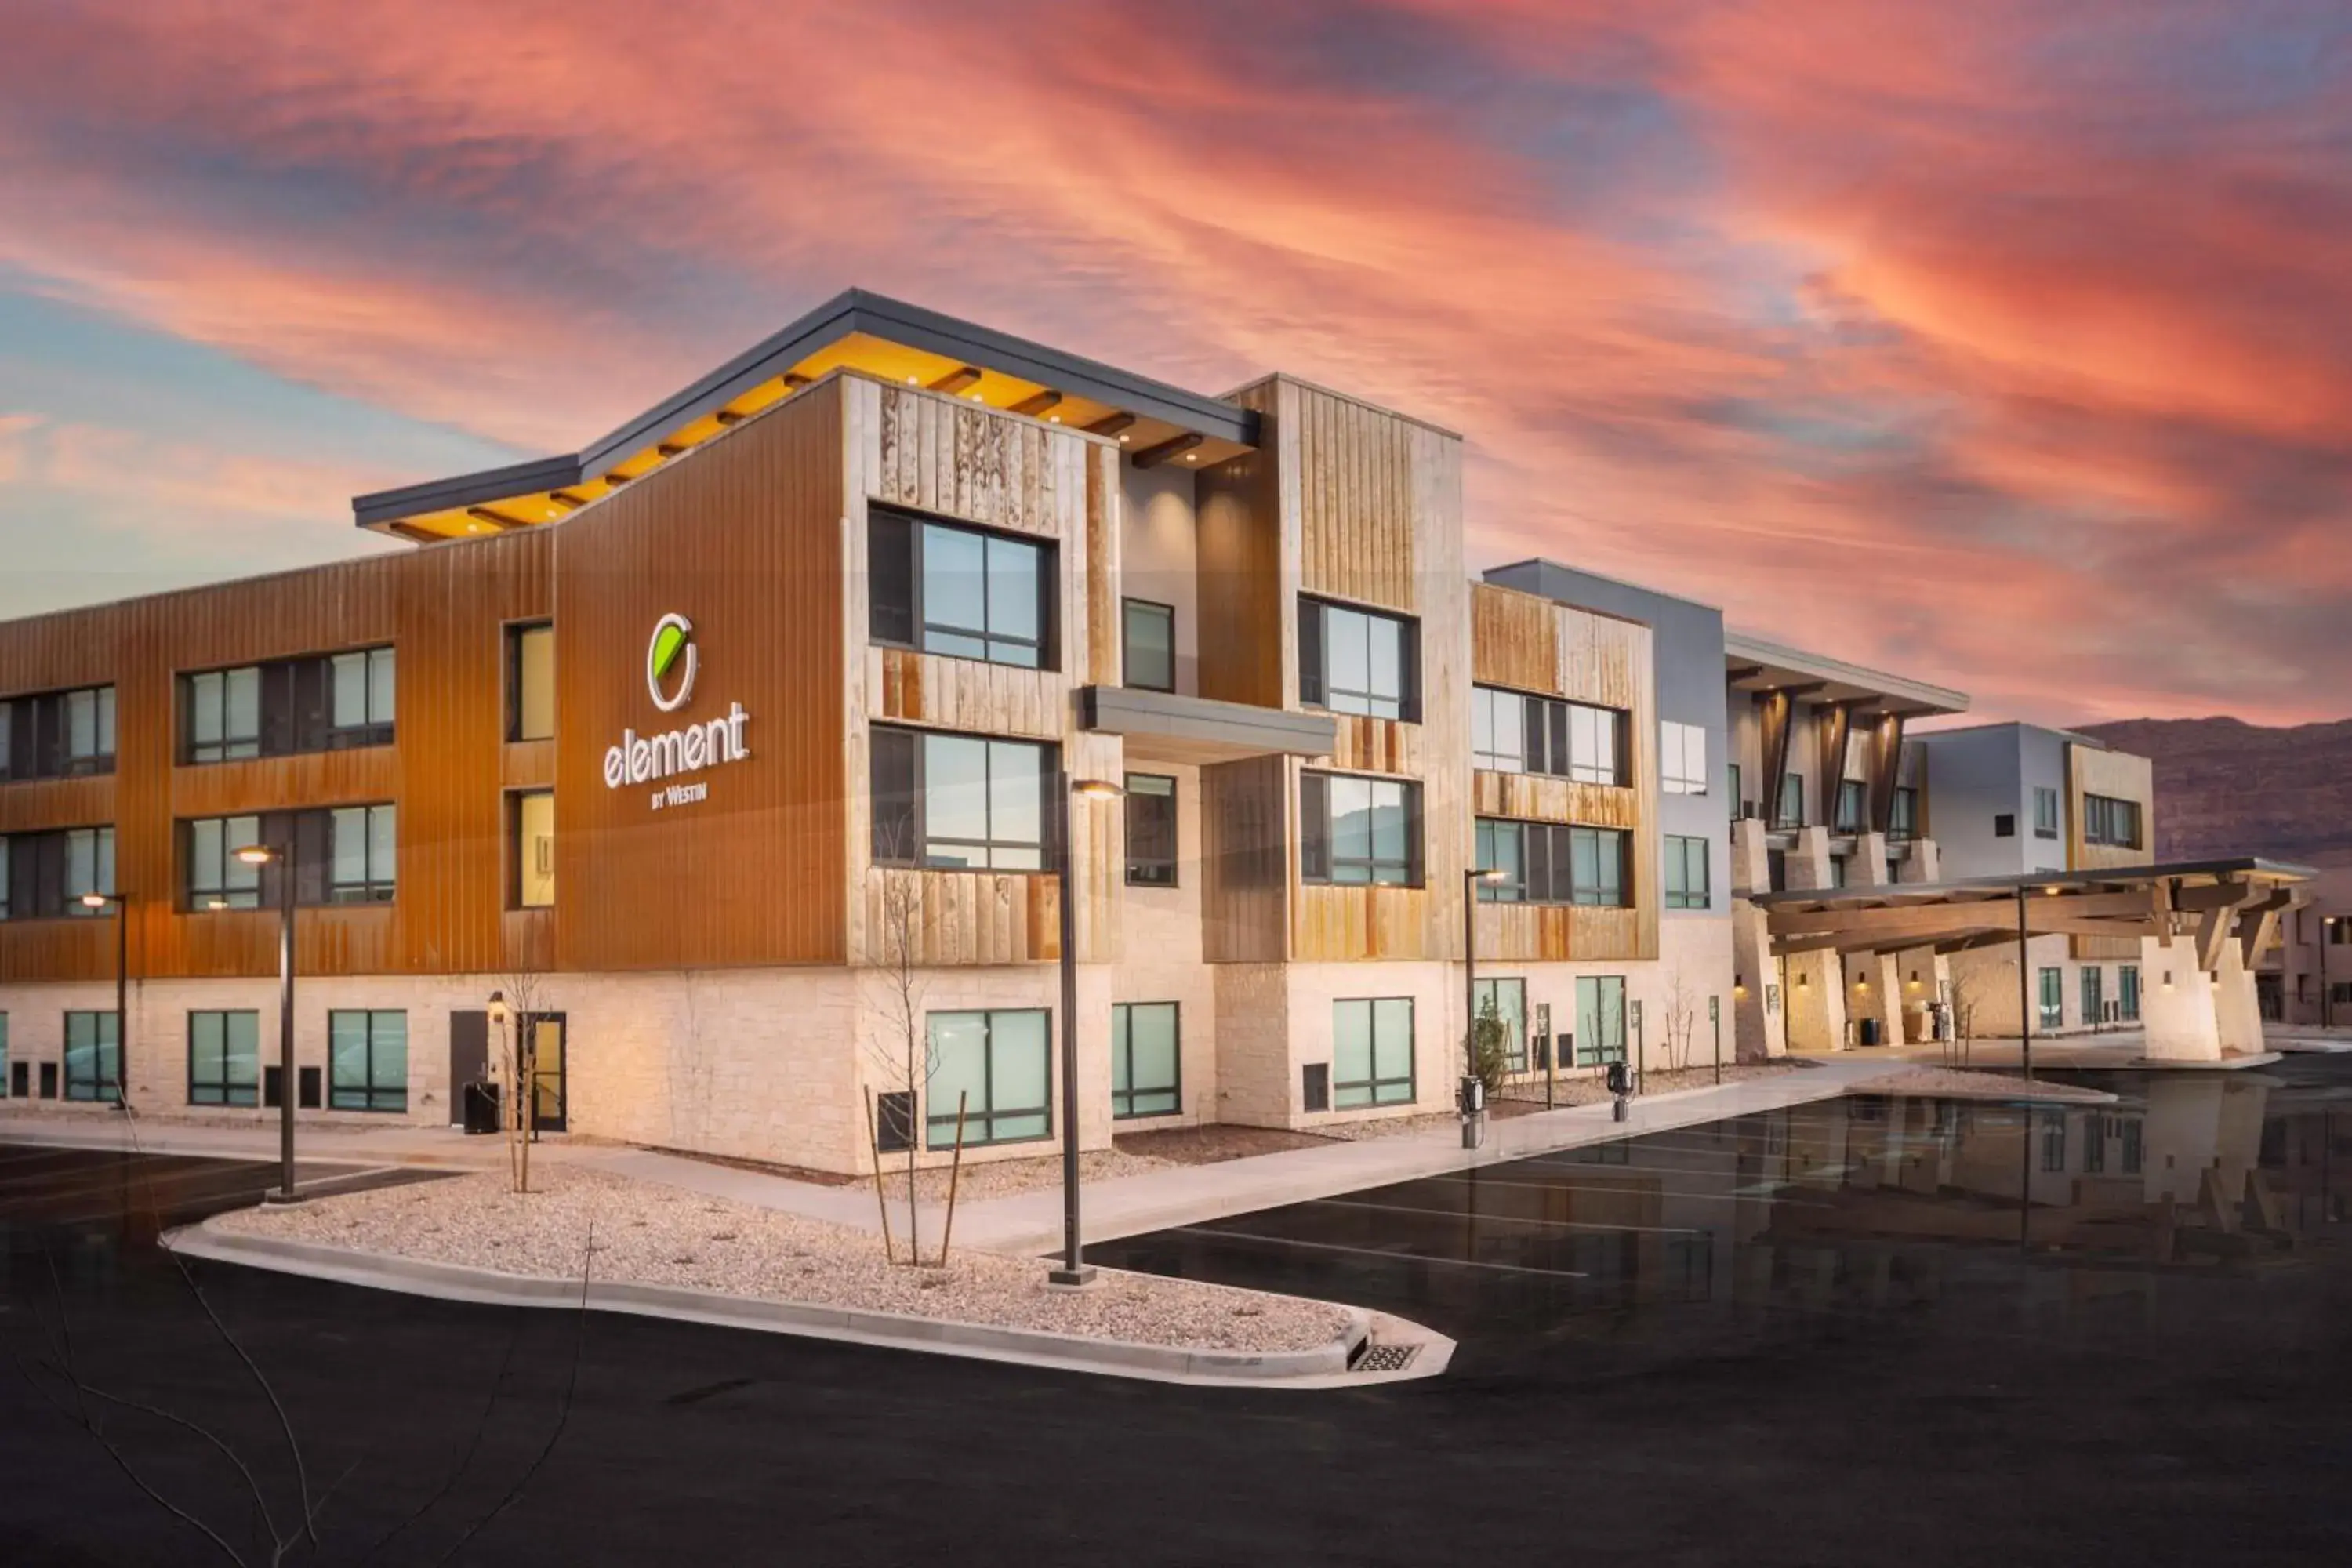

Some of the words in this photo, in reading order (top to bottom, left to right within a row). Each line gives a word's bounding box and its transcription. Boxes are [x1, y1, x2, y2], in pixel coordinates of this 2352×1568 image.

[604, 702, 750, 789] element
[652, 792, 665, 810] BY
[666, 782, 707, 807] WESTIN
